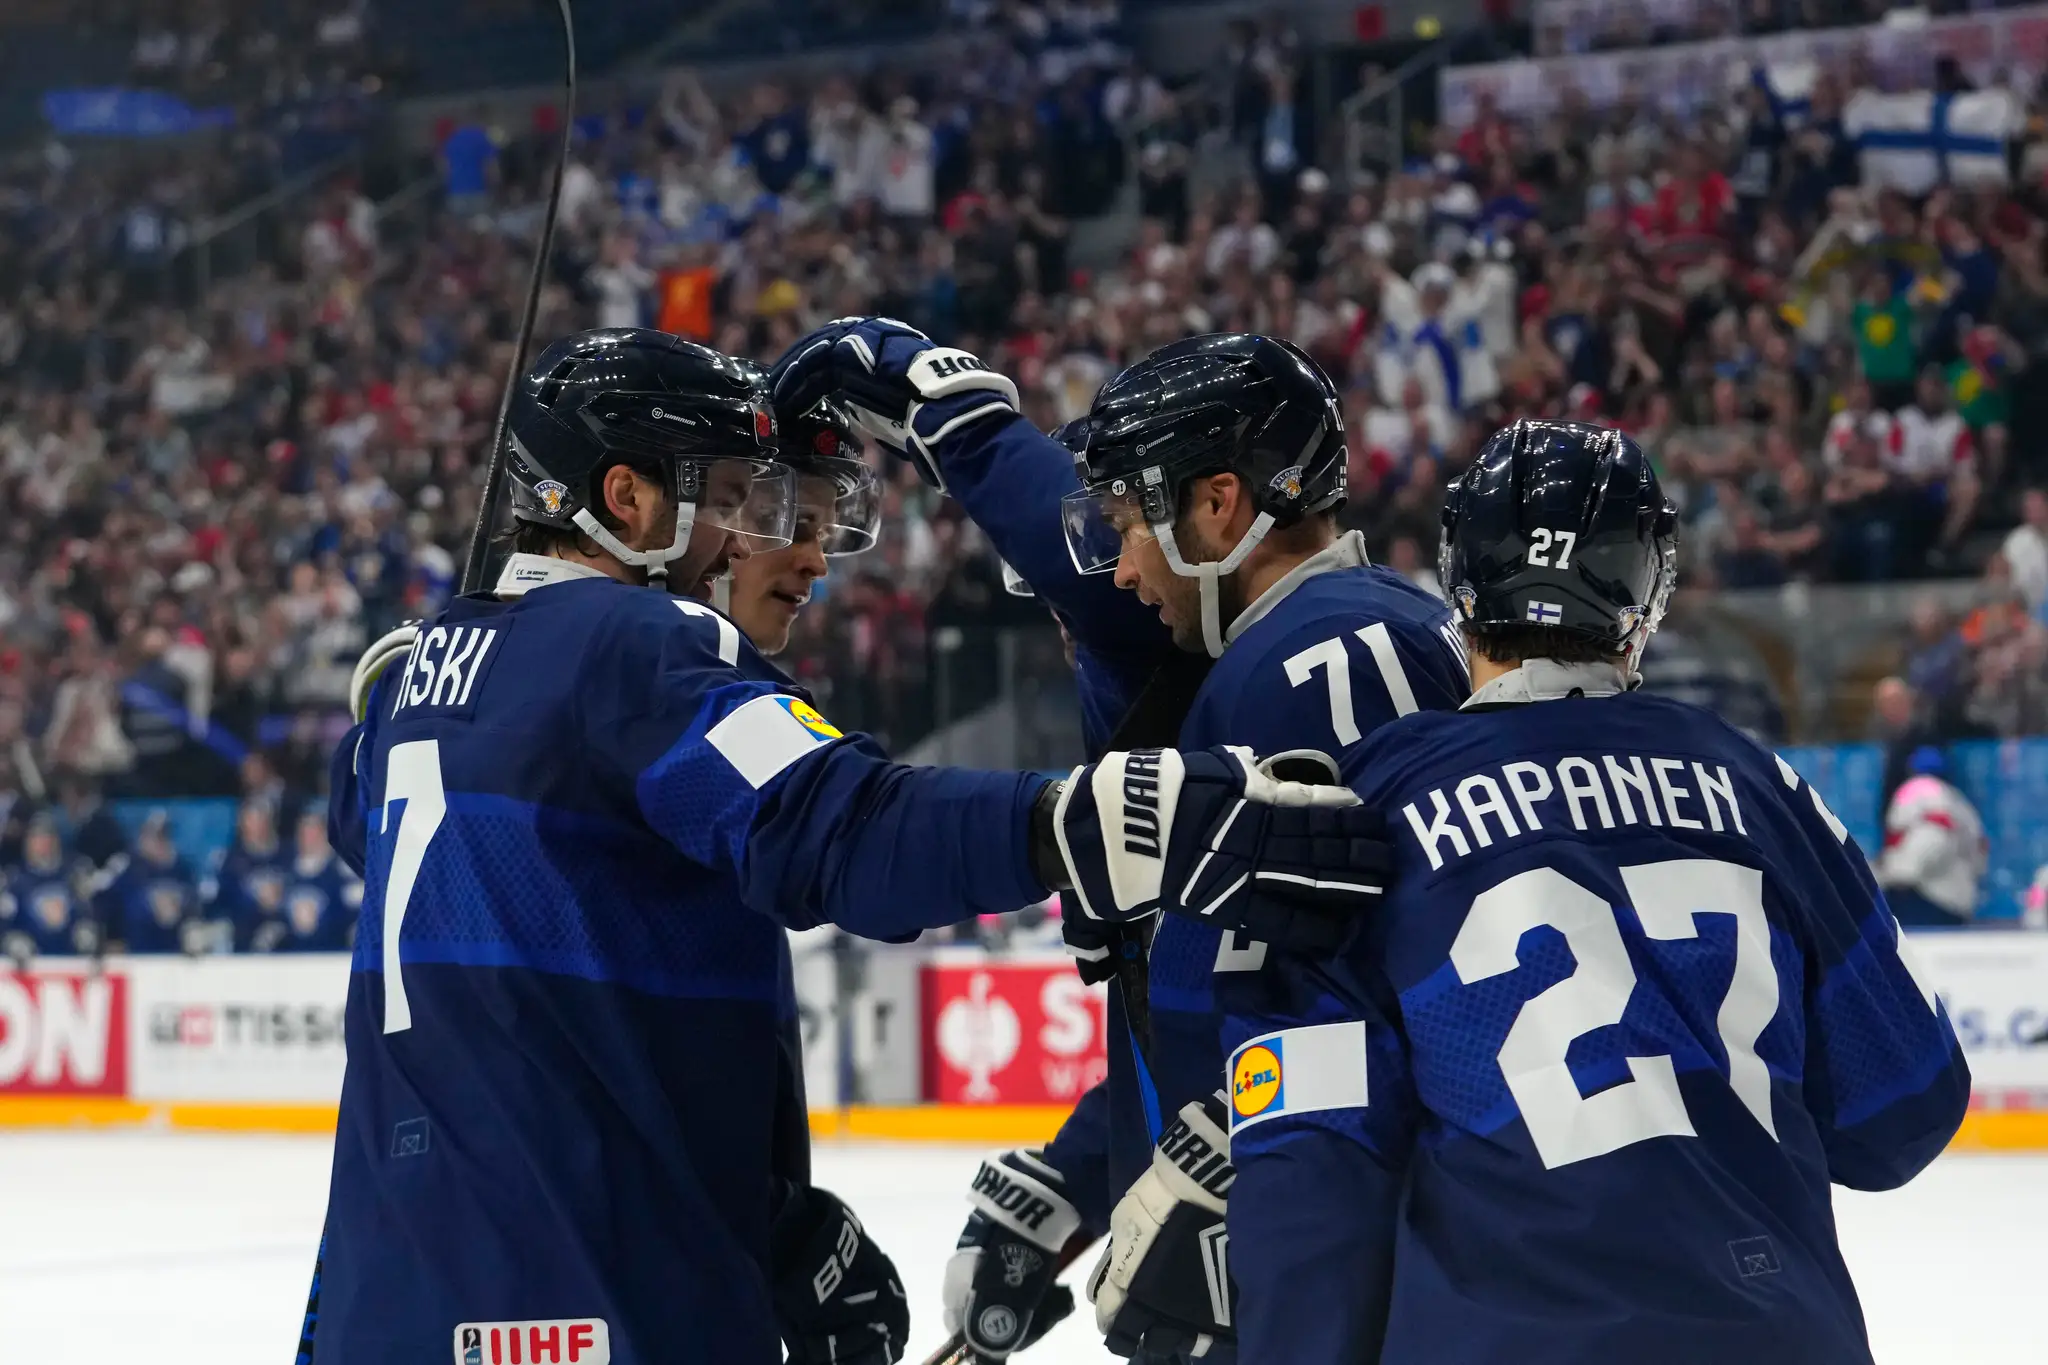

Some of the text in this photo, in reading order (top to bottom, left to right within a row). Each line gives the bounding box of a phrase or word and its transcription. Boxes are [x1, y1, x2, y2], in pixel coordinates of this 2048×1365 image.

[1528, 528, 1577, 570] 27
[672, 600, 740, 667] 7
[1282, 621, 1420, 747] 71
[1403, 754, 1748, 872] KAPANEN
[380, 738, 448, 1035] 7
[223, 1004, 346, 1047] TISS
[1449, 858, 1780, 1171] 27
[491, 1323, 594, 1365] IIHF
